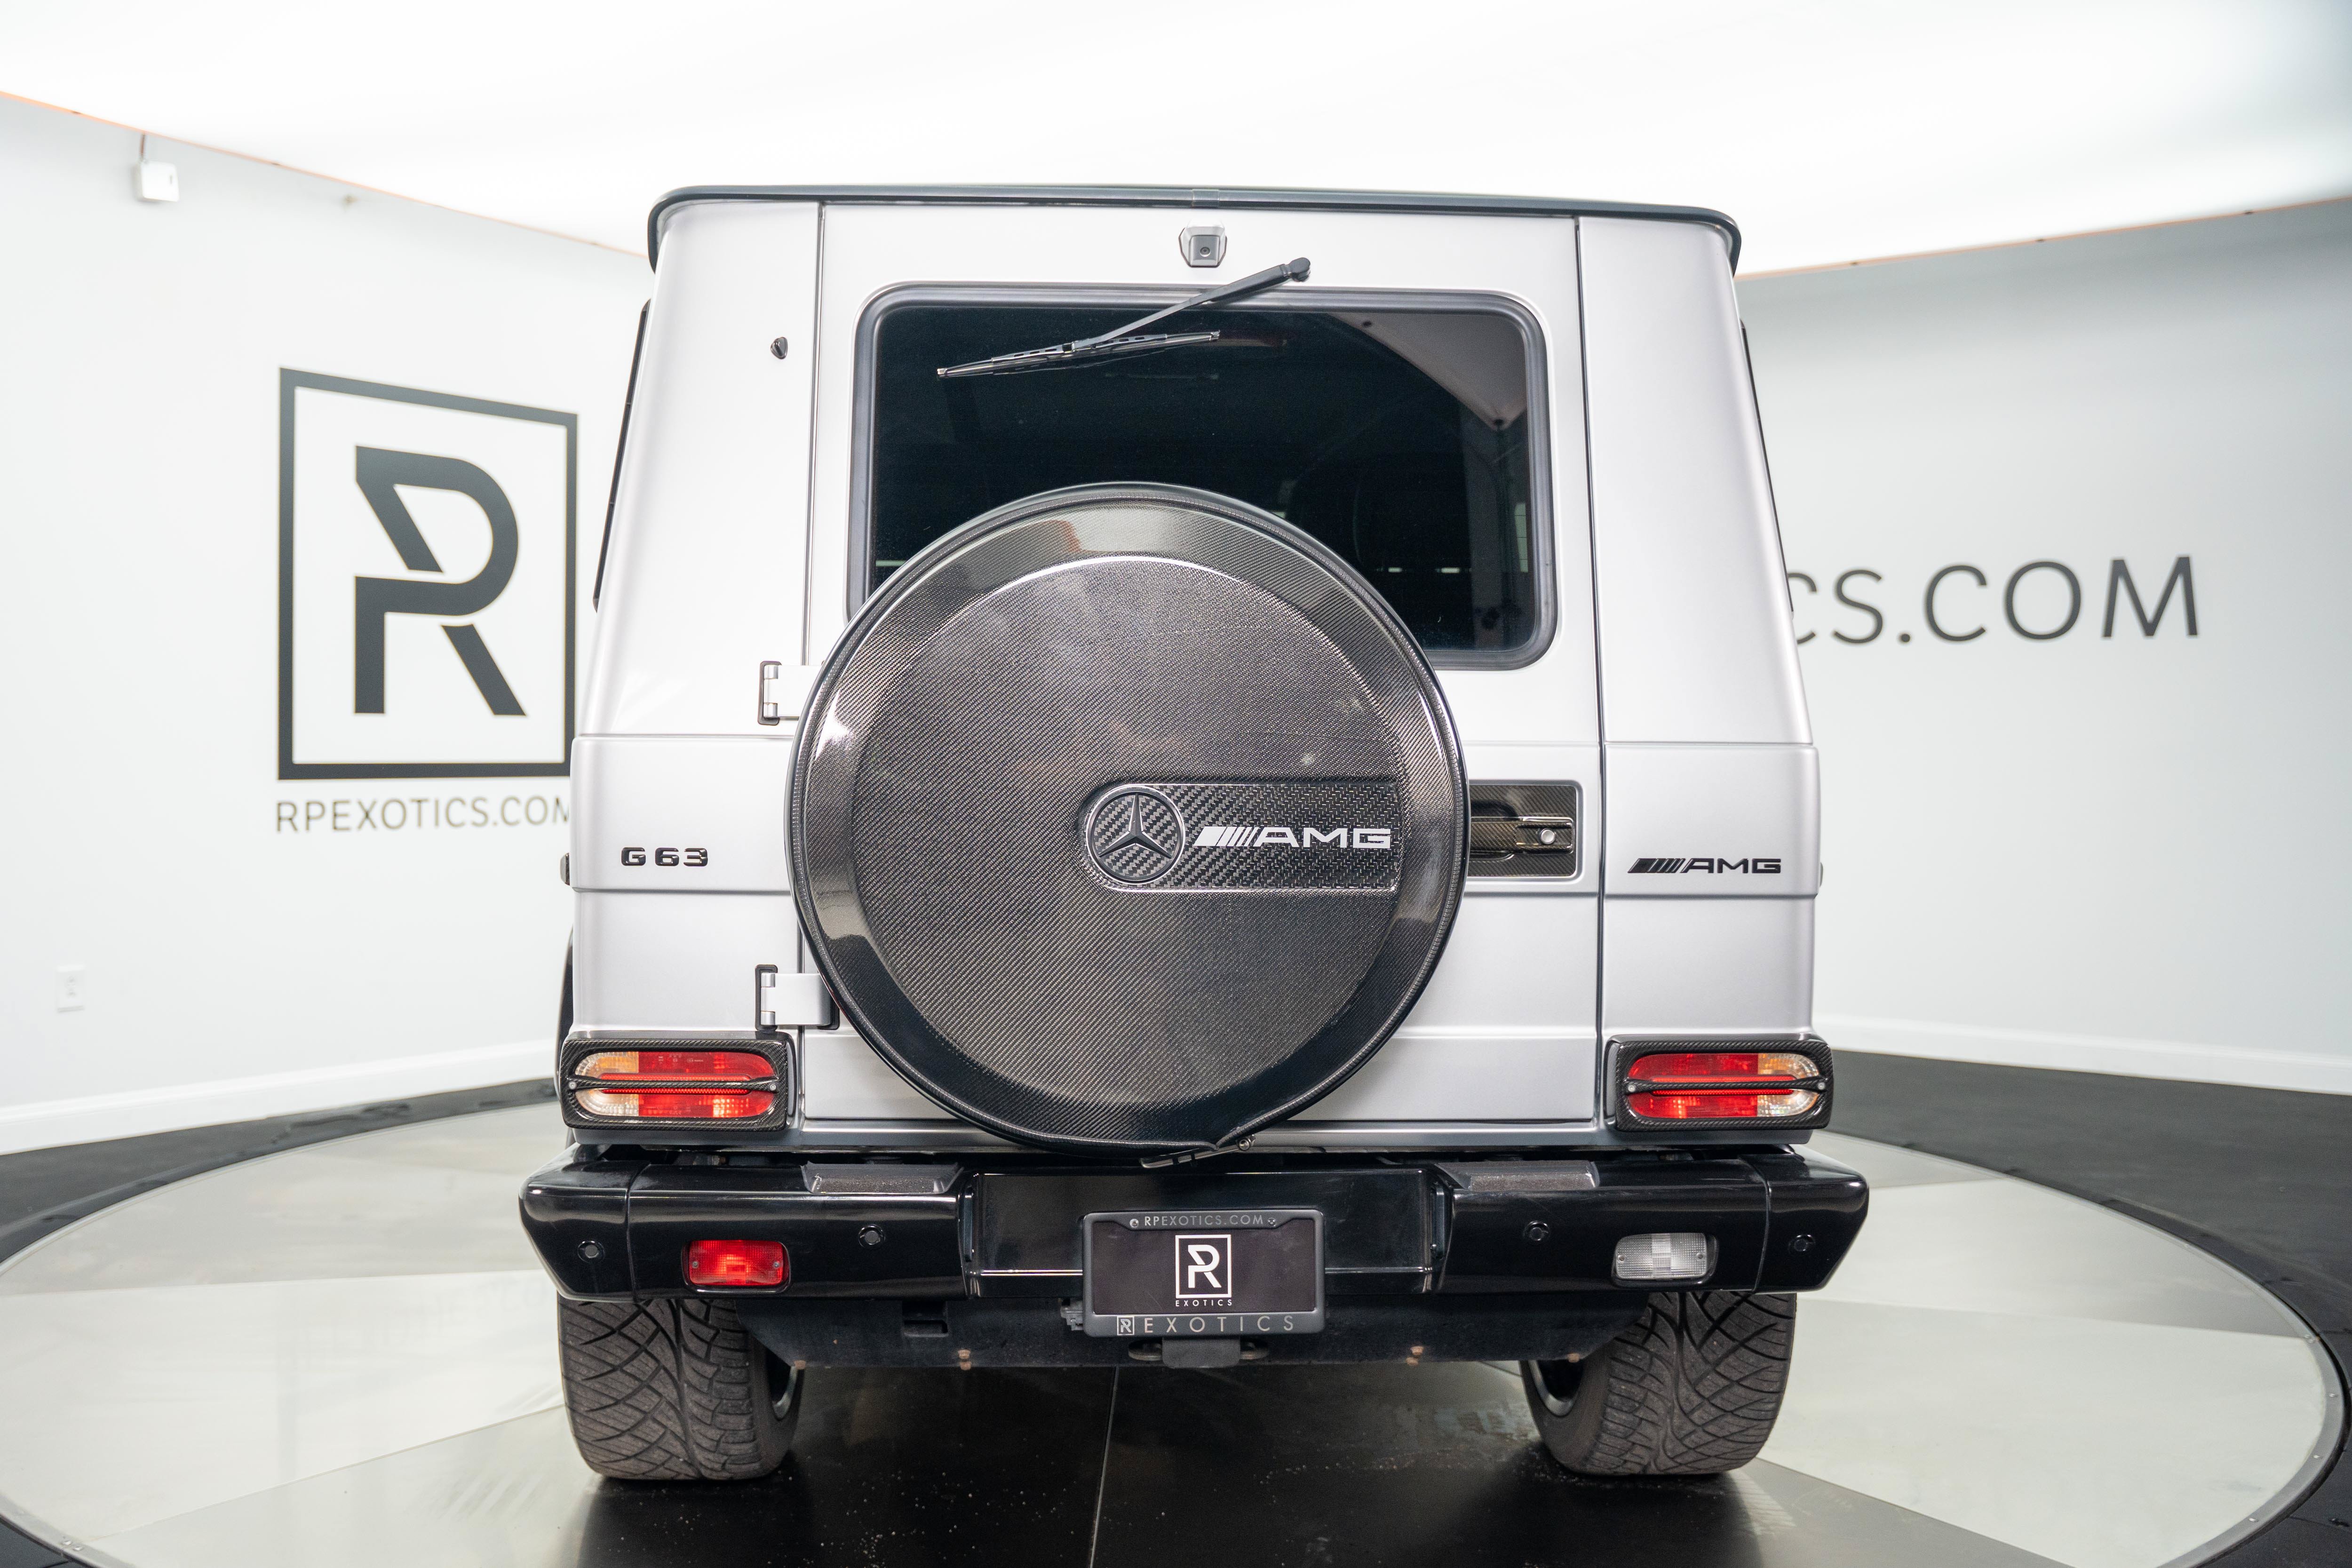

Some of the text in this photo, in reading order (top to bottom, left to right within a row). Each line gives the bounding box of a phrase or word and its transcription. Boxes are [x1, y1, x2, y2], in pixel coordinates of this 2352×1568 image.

[655, 847, 708, 867] 63
[1144, 1215, 1263, 1226] RPEXOTICS.COM
[1144, 1315, 1294, 1333] EXOTICS
